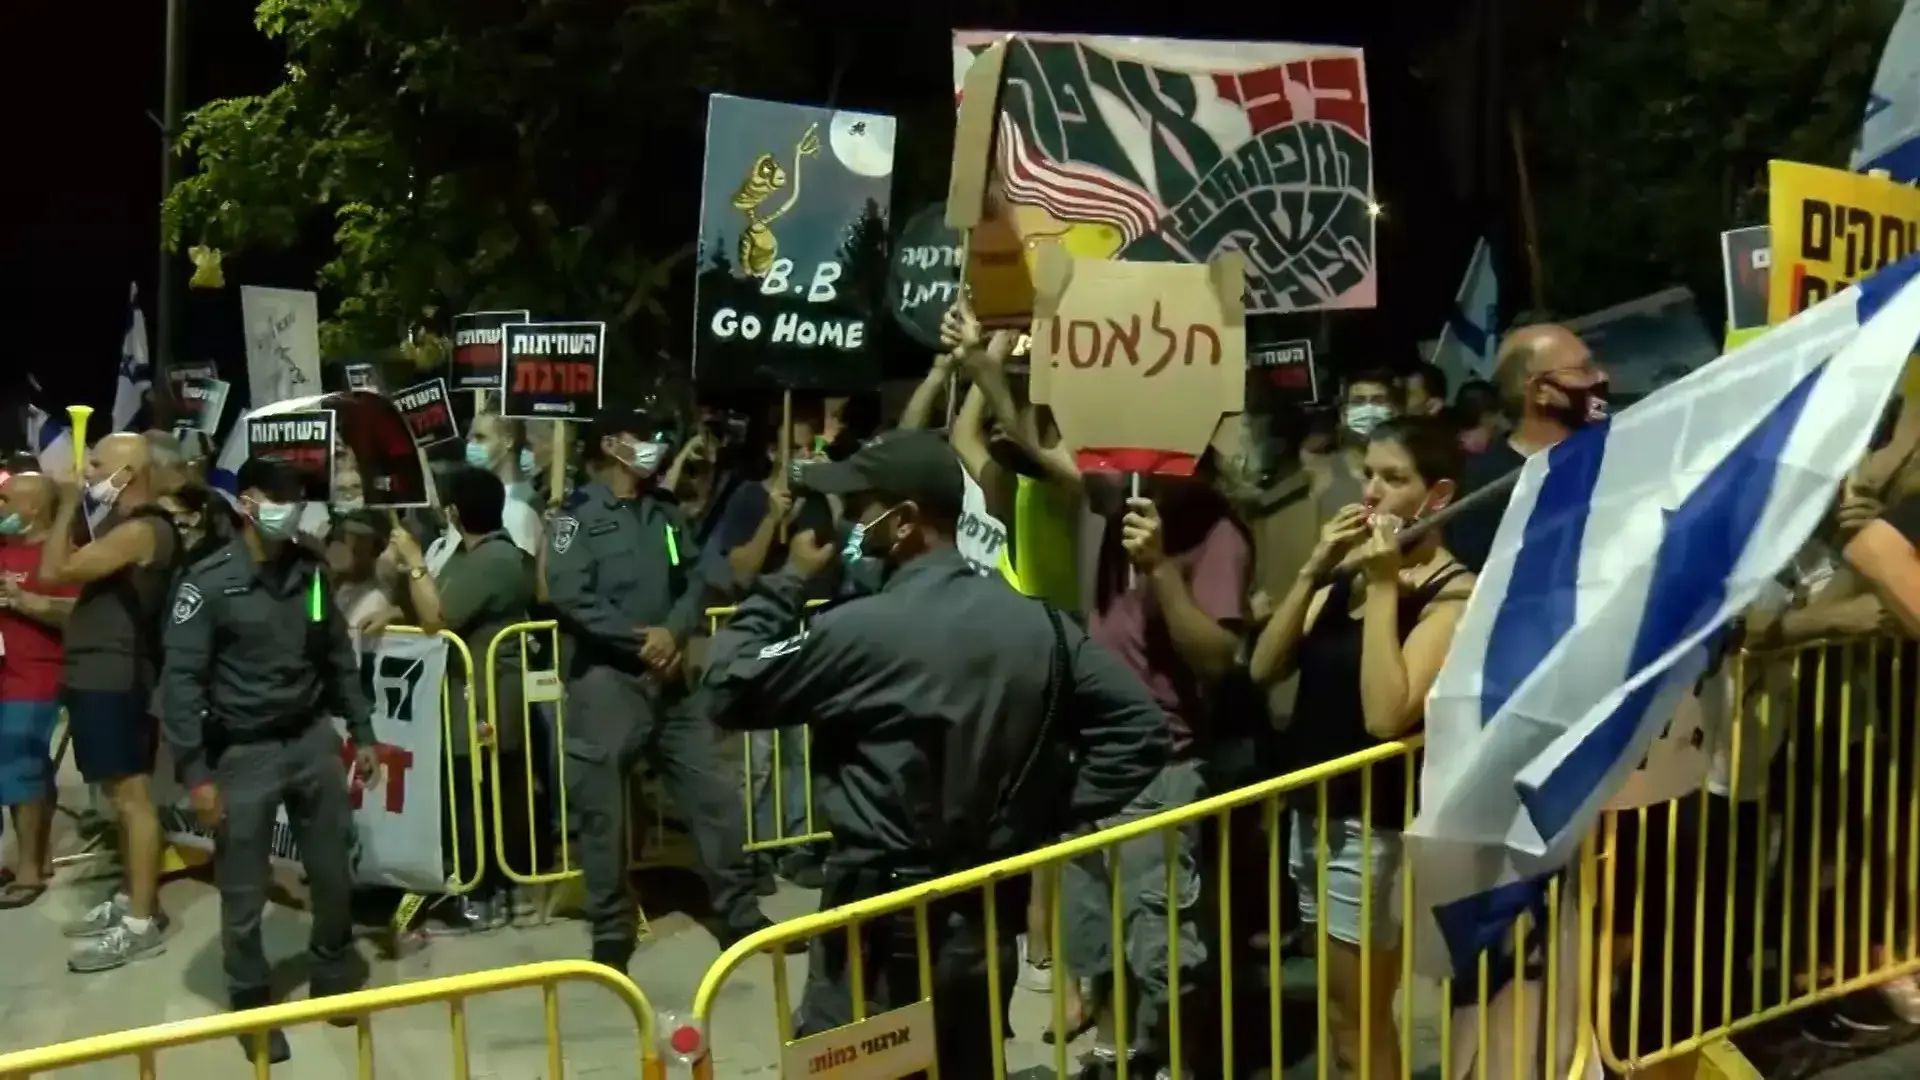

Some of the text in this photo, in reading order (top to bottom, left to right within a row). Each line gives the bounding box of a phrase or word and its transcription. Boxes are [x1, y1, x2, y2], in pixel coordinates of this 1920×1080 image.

[1801, 198, 1918, 279] ותקים
[760, 257, 842, 302] B.B
[511, 333, 597, 355] השחיתות
[711, 307, 865, 349] GO HOME
[250, 420, 328, 443] השחיתות
